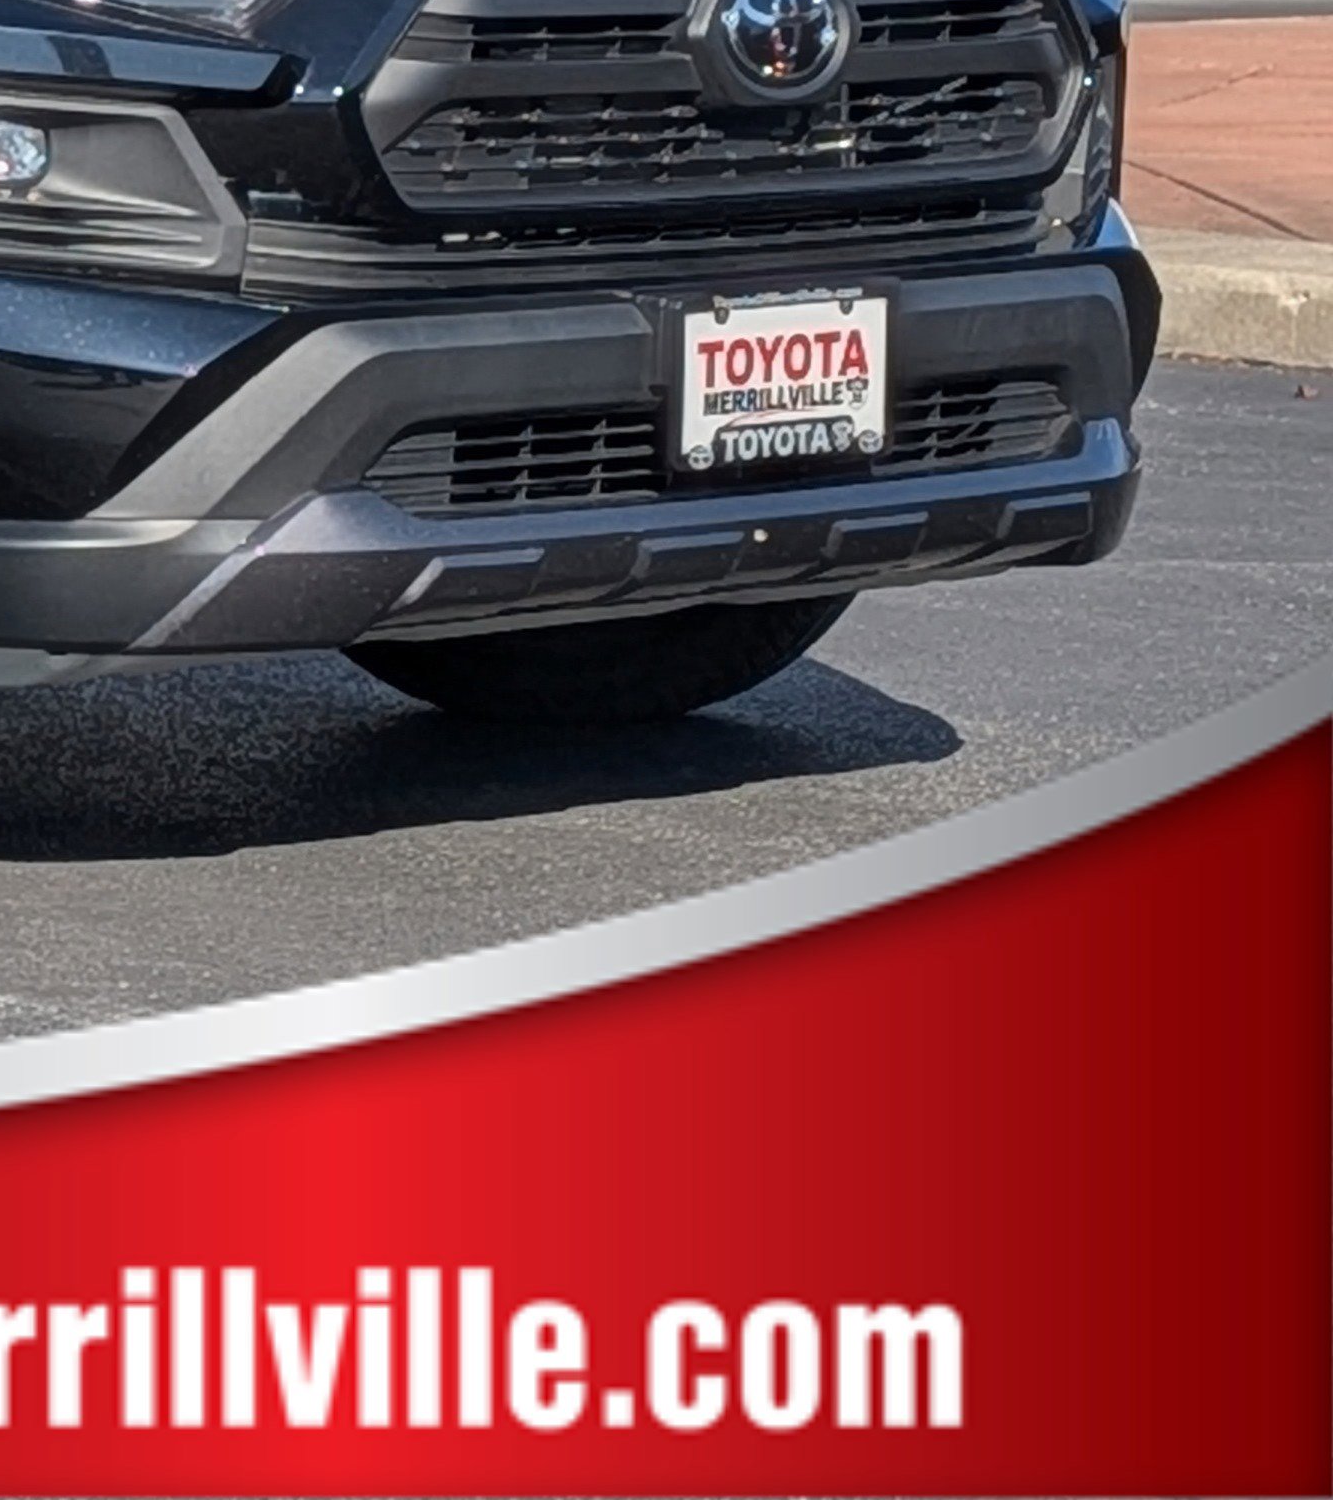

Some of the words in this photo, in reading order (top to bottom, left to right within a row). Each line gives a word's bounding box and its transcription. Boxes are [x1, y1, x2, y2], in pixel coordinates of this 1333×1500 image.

[697, 329, 869, 388] TOYOTA
[702, 378, 844, 416] MERRILLVILLE
[719, 419, 833, 463] TOYOTA
